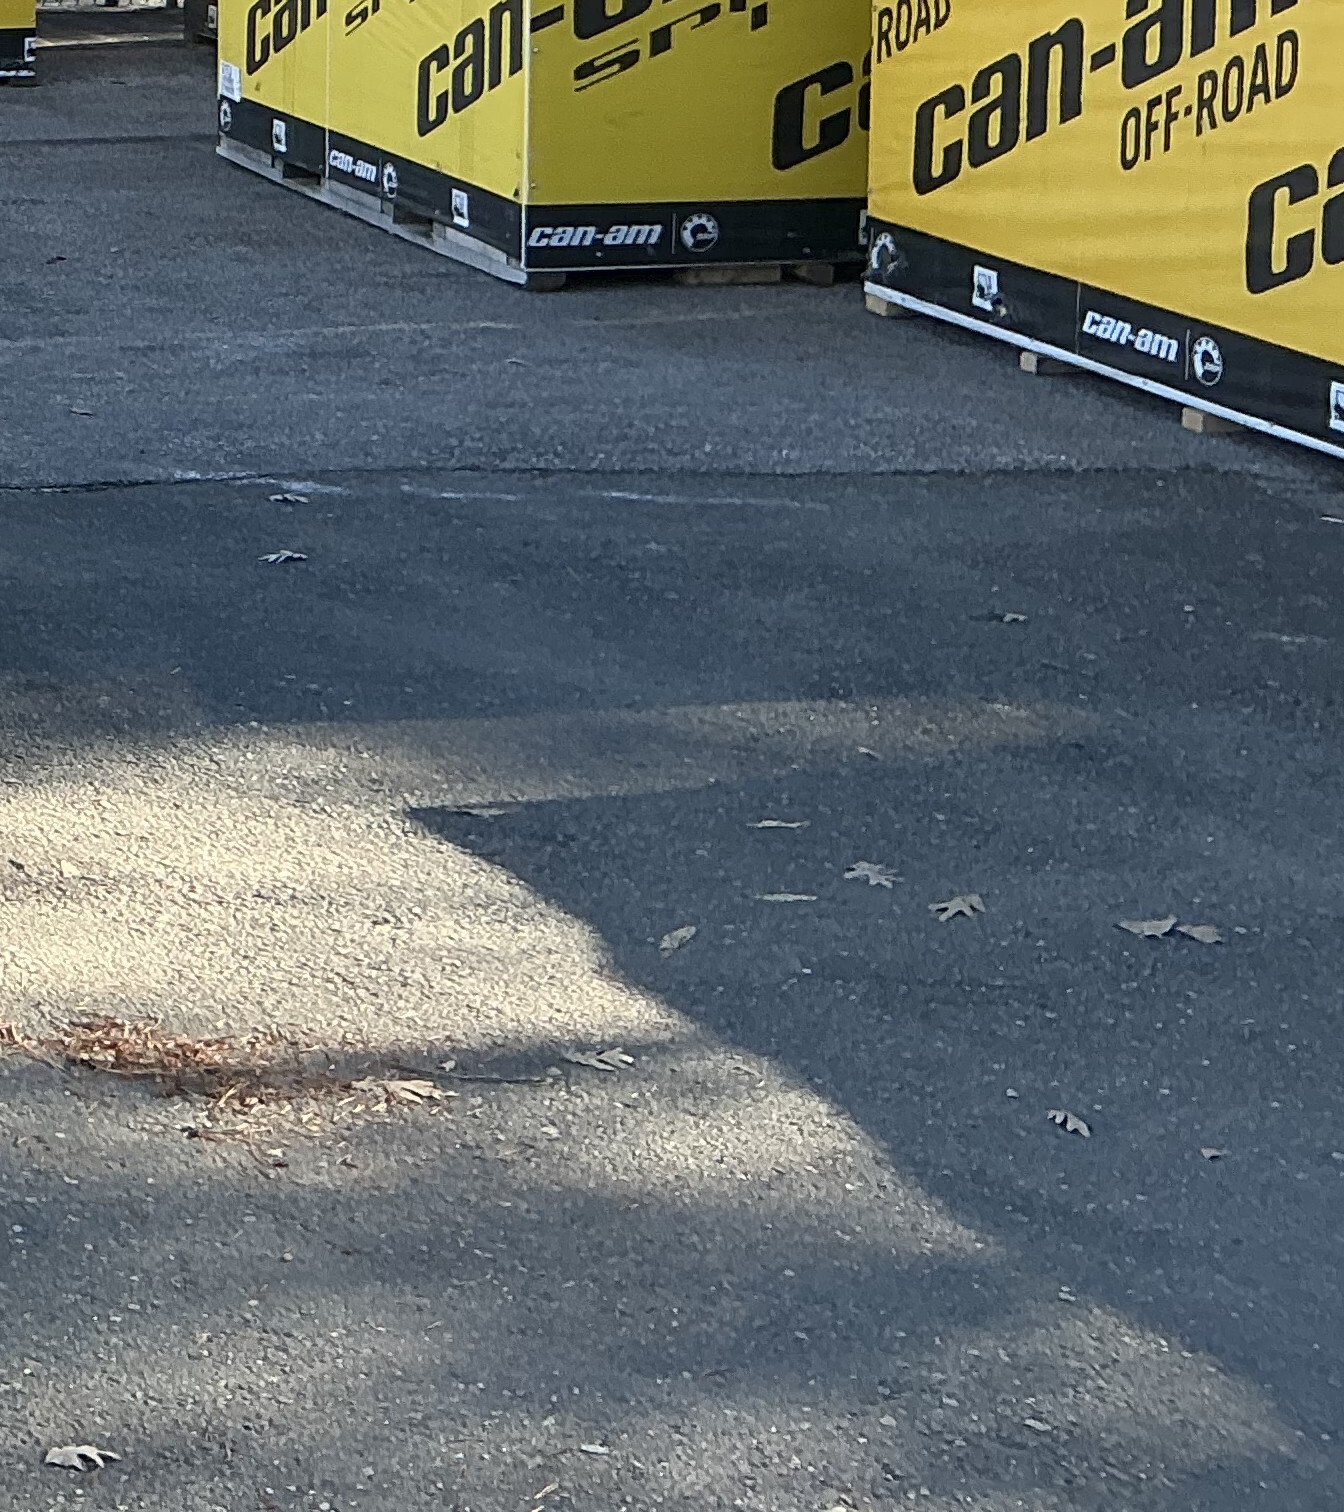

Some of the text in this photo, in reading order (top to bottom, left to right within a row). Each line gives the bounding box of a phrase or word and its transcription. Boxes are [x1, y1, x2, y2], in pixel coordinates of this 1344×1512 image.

[1120, 28, 1299, 171] OFF-ROAD
[329, 149, 377, 183] can-am
[527, 223, 663, 248] can-am
[1082, 310, 1180, 363] can-am
